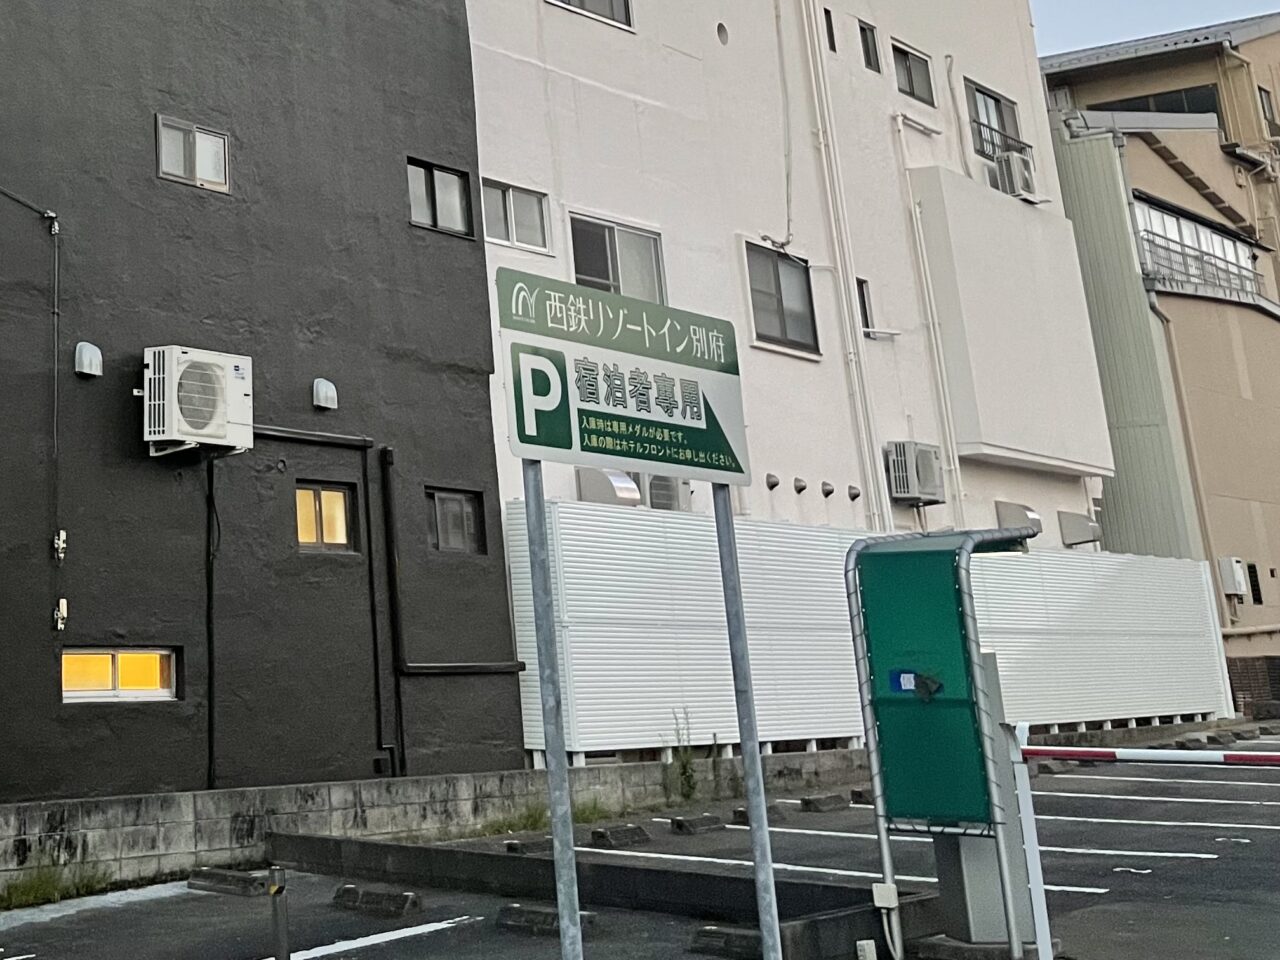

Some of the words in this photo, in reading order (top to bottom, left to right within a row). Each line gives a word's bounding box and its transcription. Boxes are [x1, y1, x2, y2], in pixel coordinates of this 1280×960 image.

[545, 290, 725, 364] 西鉄リゾートイン別府
[519, 352, 562, 437] P
